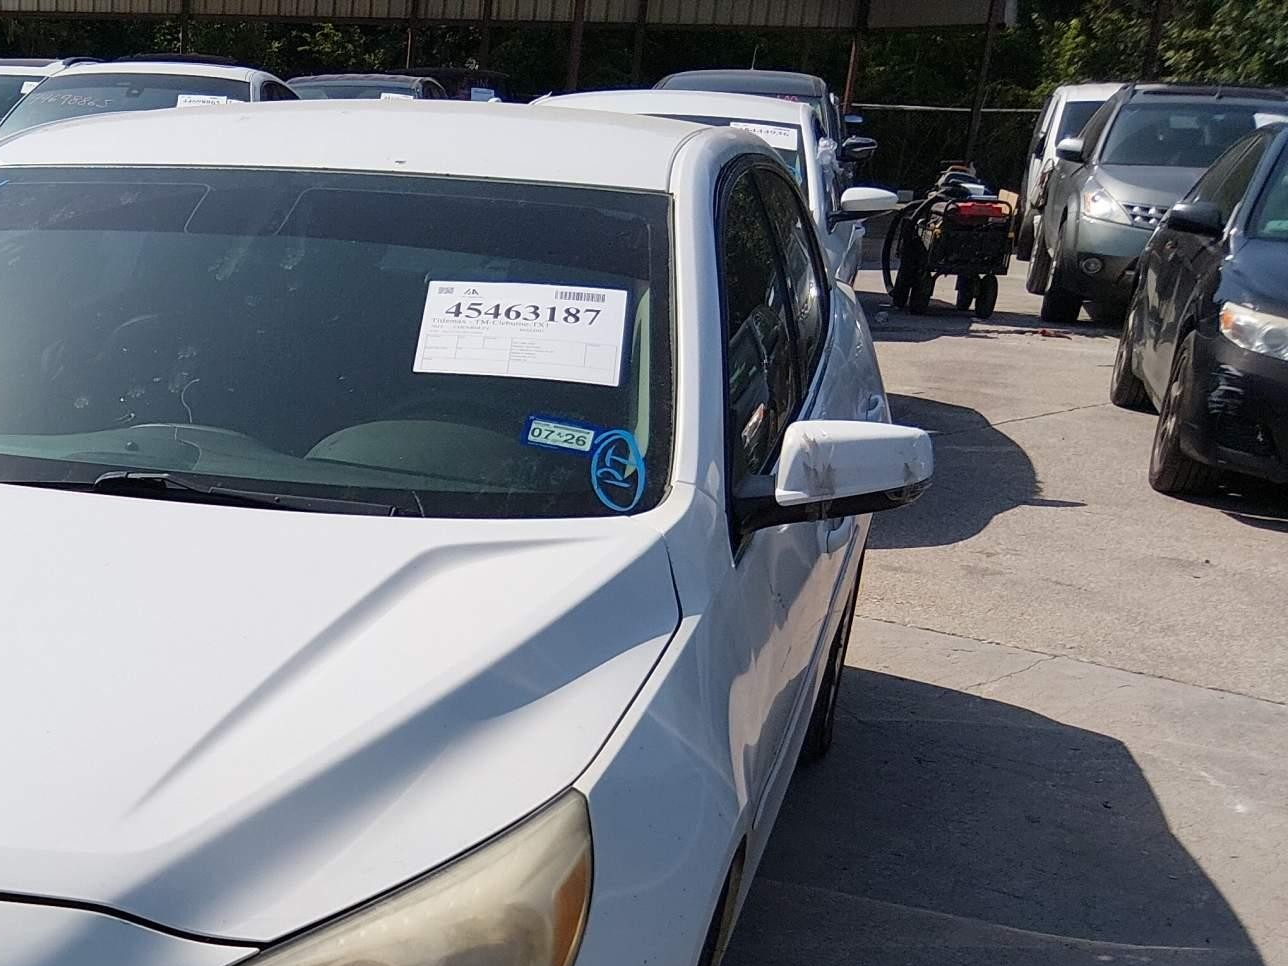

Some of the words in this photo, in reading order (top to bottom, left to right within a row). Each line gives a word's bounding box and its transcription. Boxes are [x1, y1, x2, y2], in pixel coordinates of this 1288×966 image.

[444, 300, 603, 327] 45463187
[530, 427, 555, 440] 07
[563, 433, 588, 447] 26
